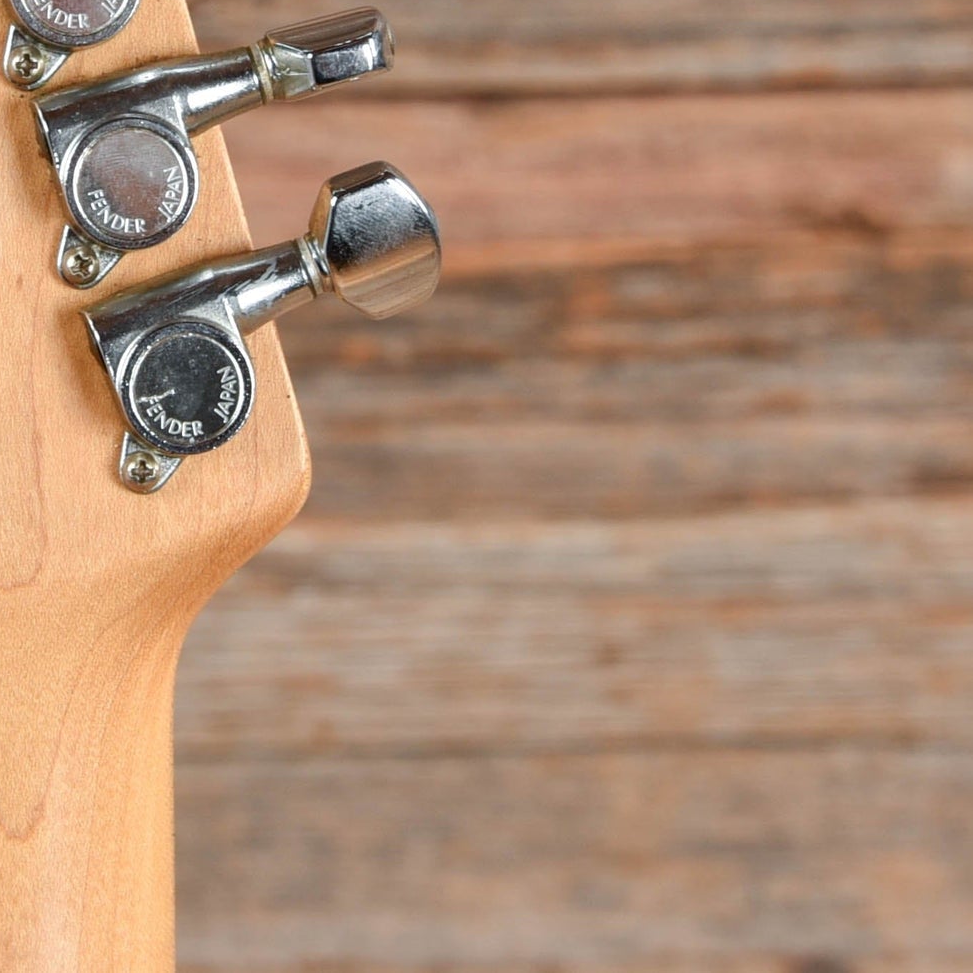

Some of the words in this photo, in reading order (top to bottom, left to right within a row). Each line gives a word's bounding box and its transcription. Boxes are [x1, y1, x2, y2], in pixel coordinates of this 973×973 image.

[88, 189, 146, 233] FENDER
[158, 166, 183, 223] JAPAN
[140, 394, 204, 437] FENDER
[214, 366, 237, 423] JAPAN
